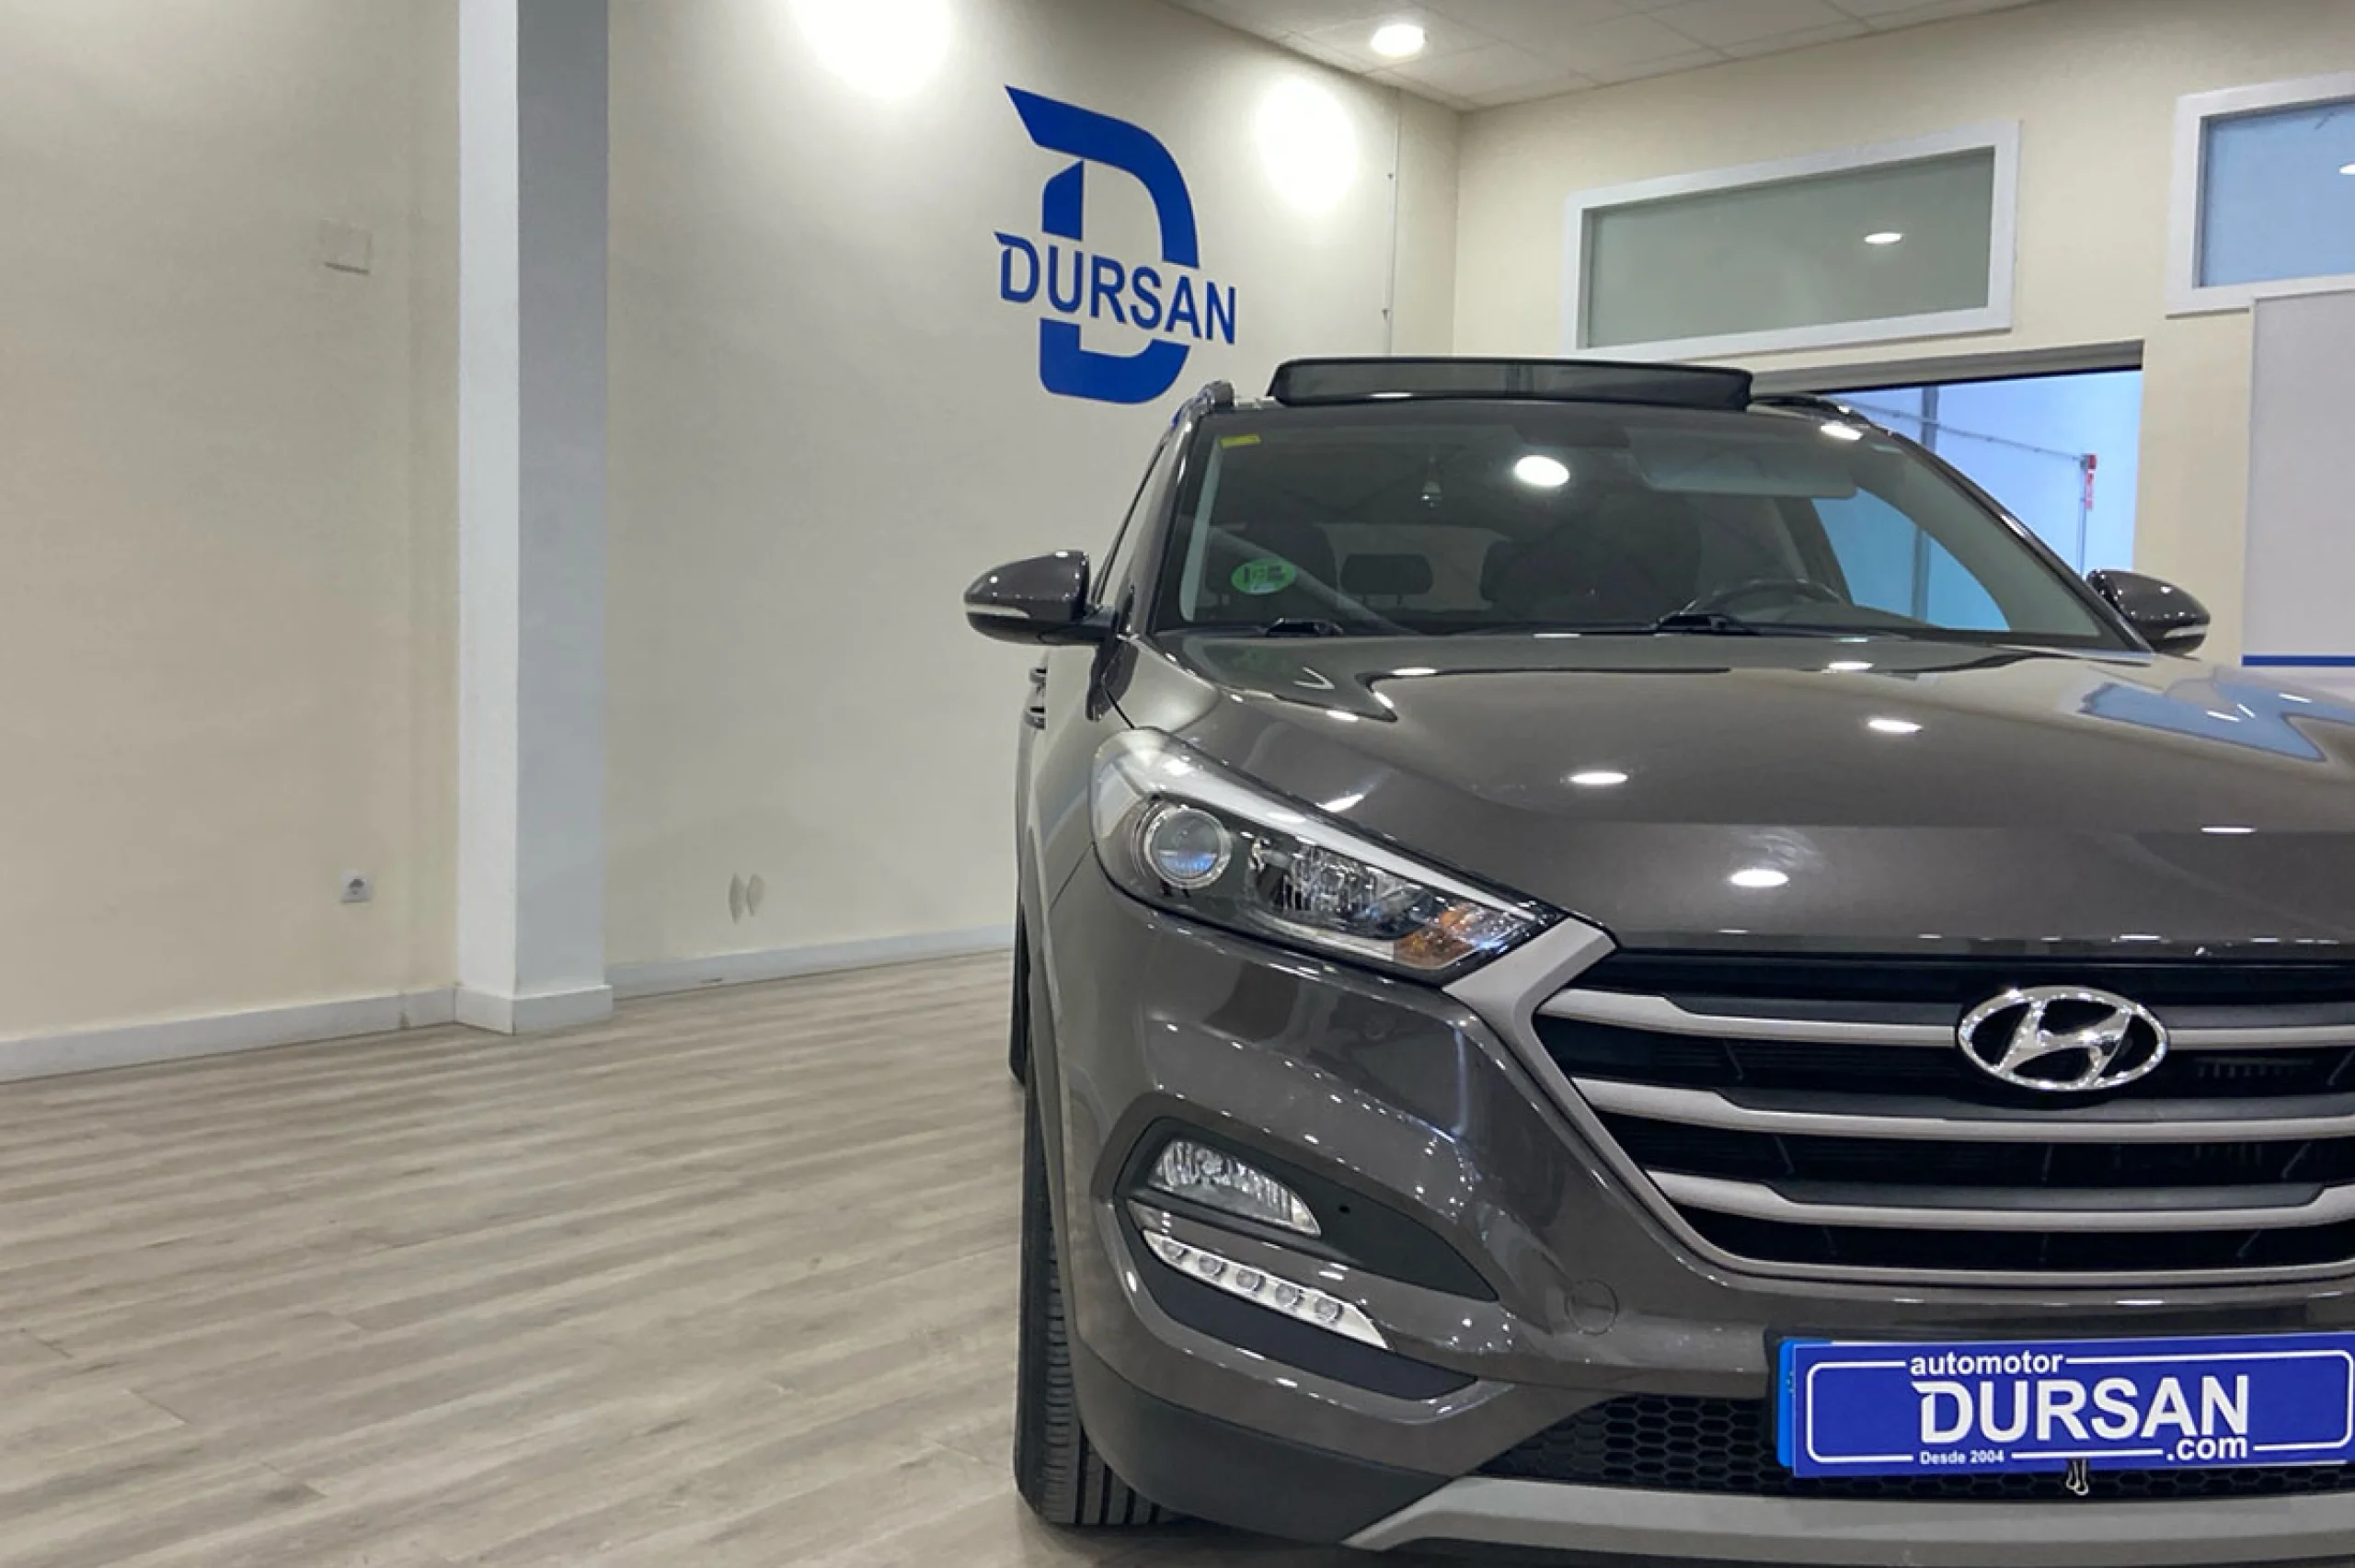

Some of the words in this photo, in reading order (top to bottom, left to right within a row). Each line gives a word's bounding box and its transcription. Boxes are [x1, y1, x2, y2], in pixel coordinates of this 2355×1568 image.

[994, 231, 1235, 345] DURSAN
[1910, 1350, 2063, 1375] automotor
[1911, 1375, 2248, 1443] DURSAN
[1920, 1451, 1967, 1465] Desde
[1970, 1449, 2005, 1464] 2004
[2166, 1437, 2248, 1460] .com
